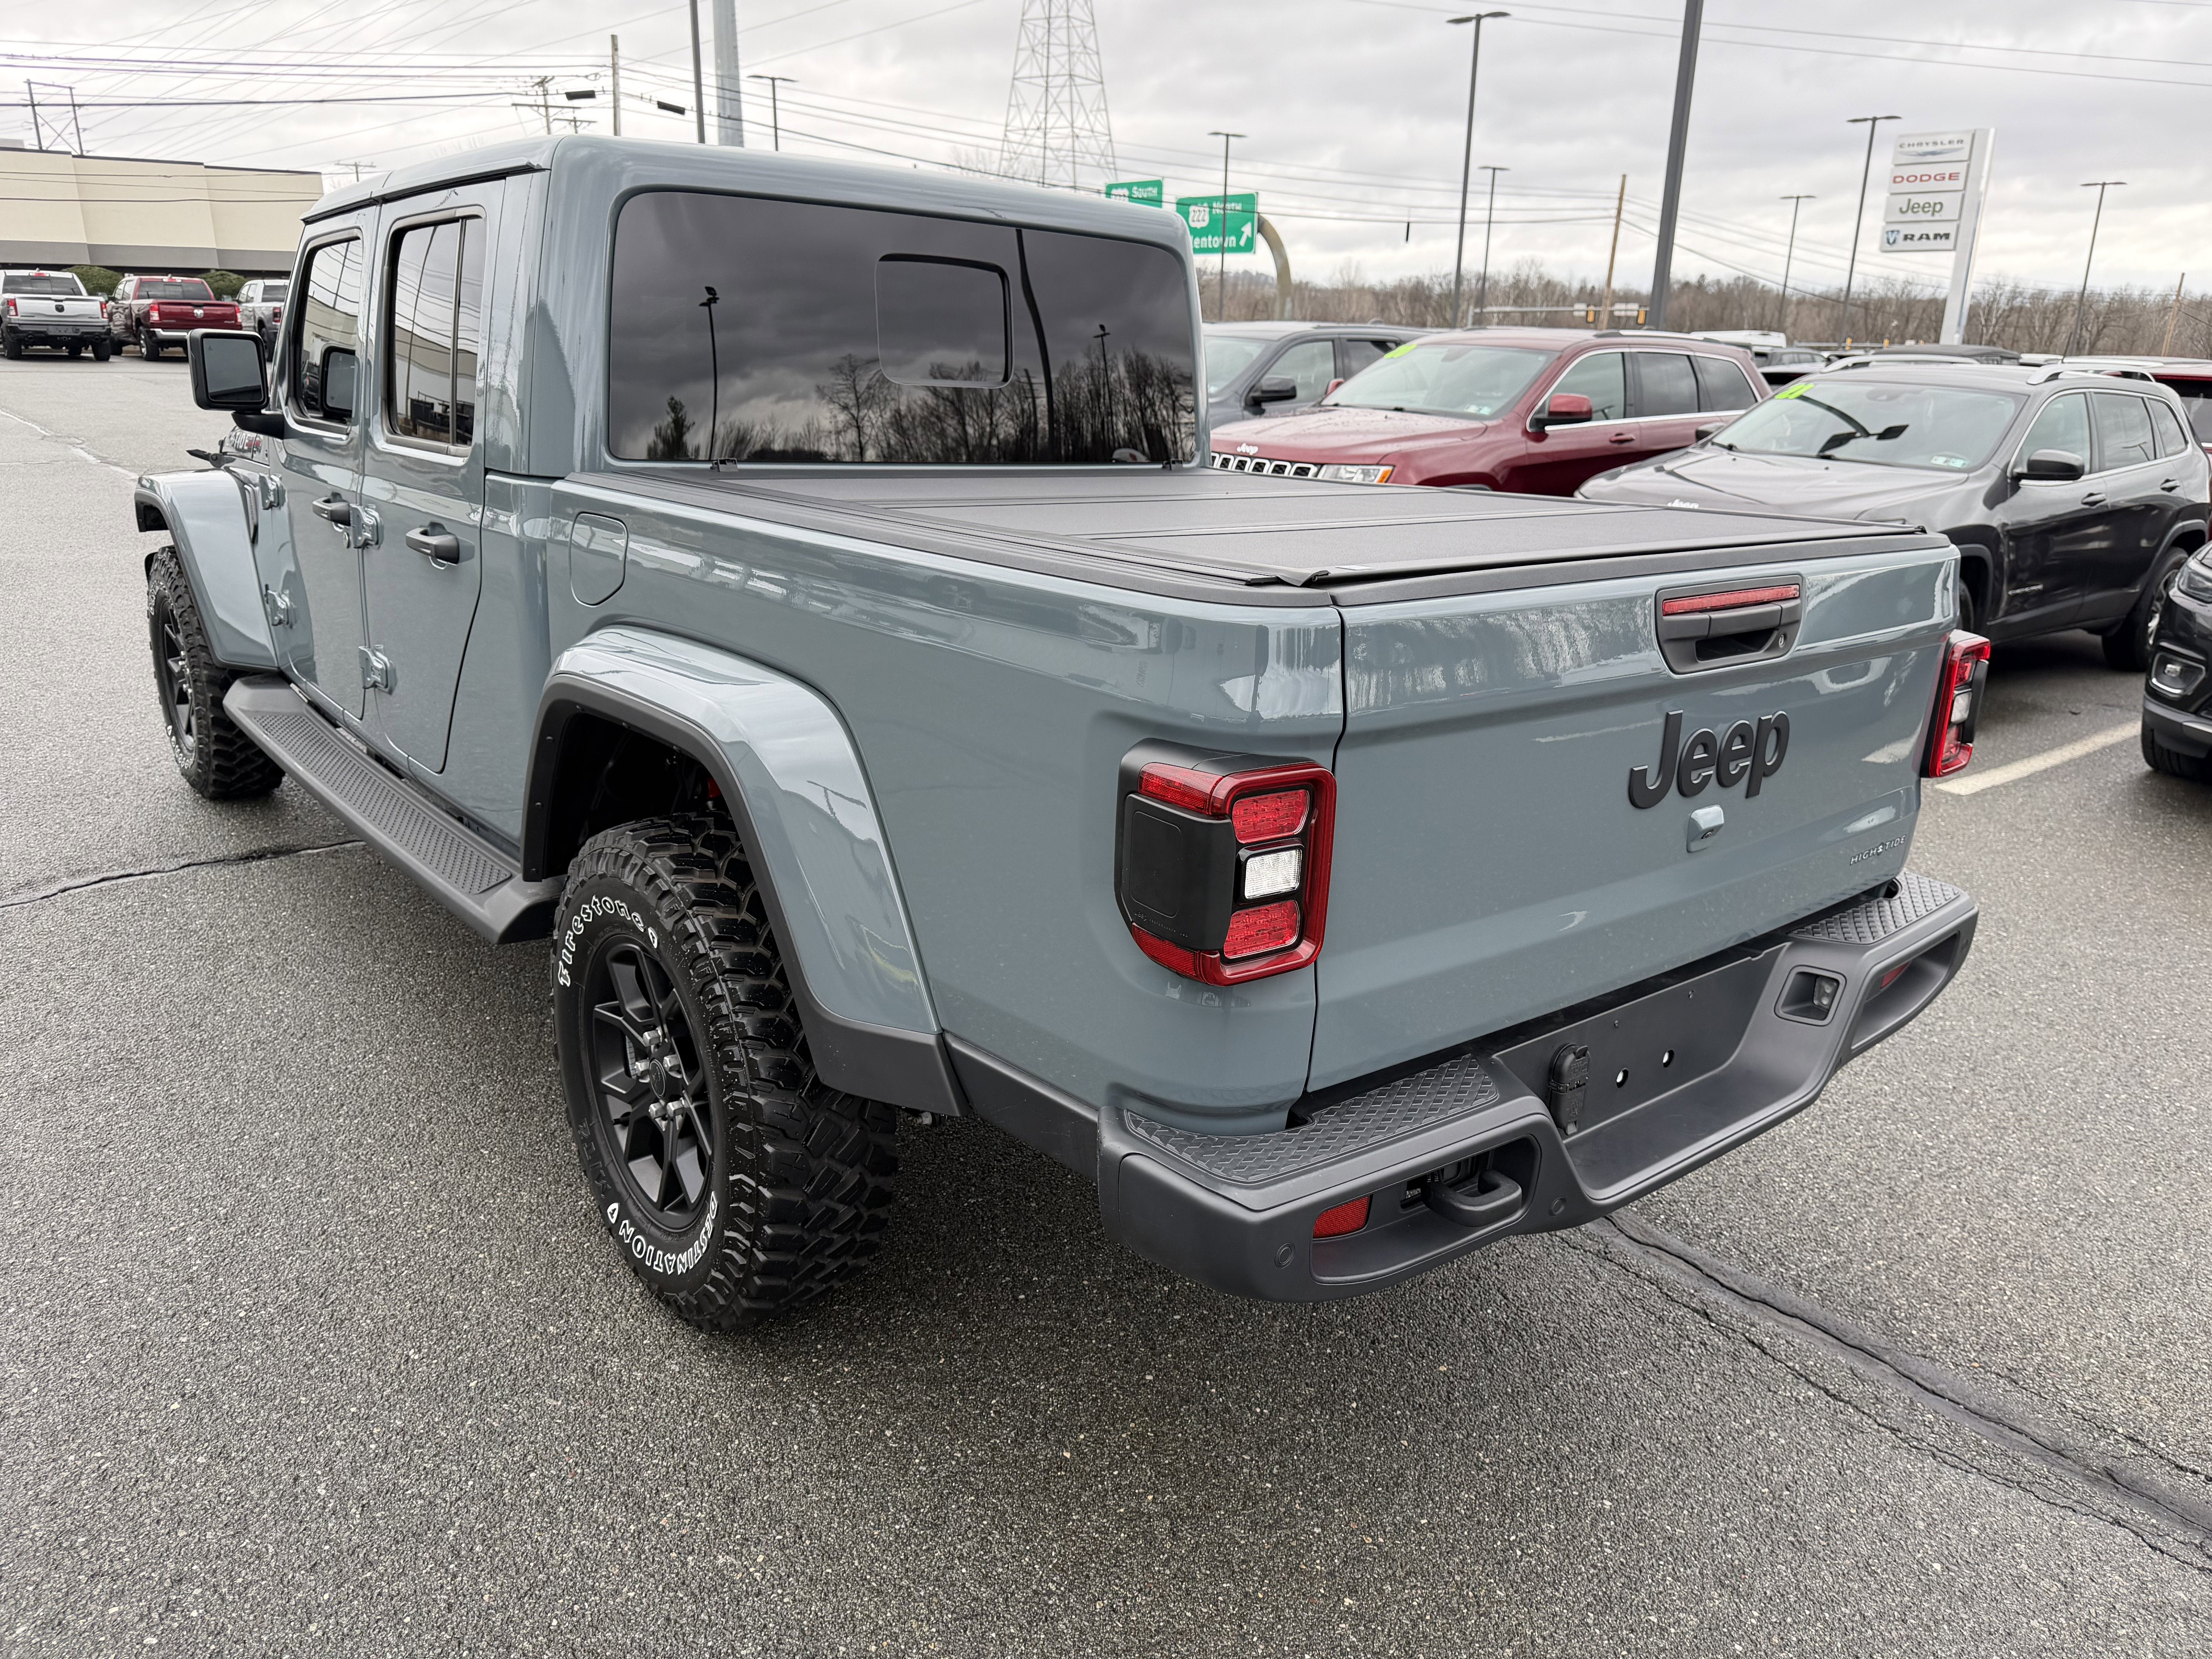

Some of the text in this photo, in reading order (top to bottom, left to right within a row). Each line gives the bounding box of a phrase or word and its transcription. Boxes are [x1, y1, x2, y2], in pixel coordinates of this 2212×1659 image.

[1899, 139, 1964, 148] CHRYSLER
[1892, 172, 1960, 184] DODGE
[1899, 198, 1944, 217] Jeep
[1903, 232, 1951, 242] RAM
[1628, 709, 1790, 809] Jeep
[1850, 834, 1907, 866] HIGH TIDE
[558, 894, 647, 987] Firestone
[619, 1190, 719, 1275] DESTINATION
